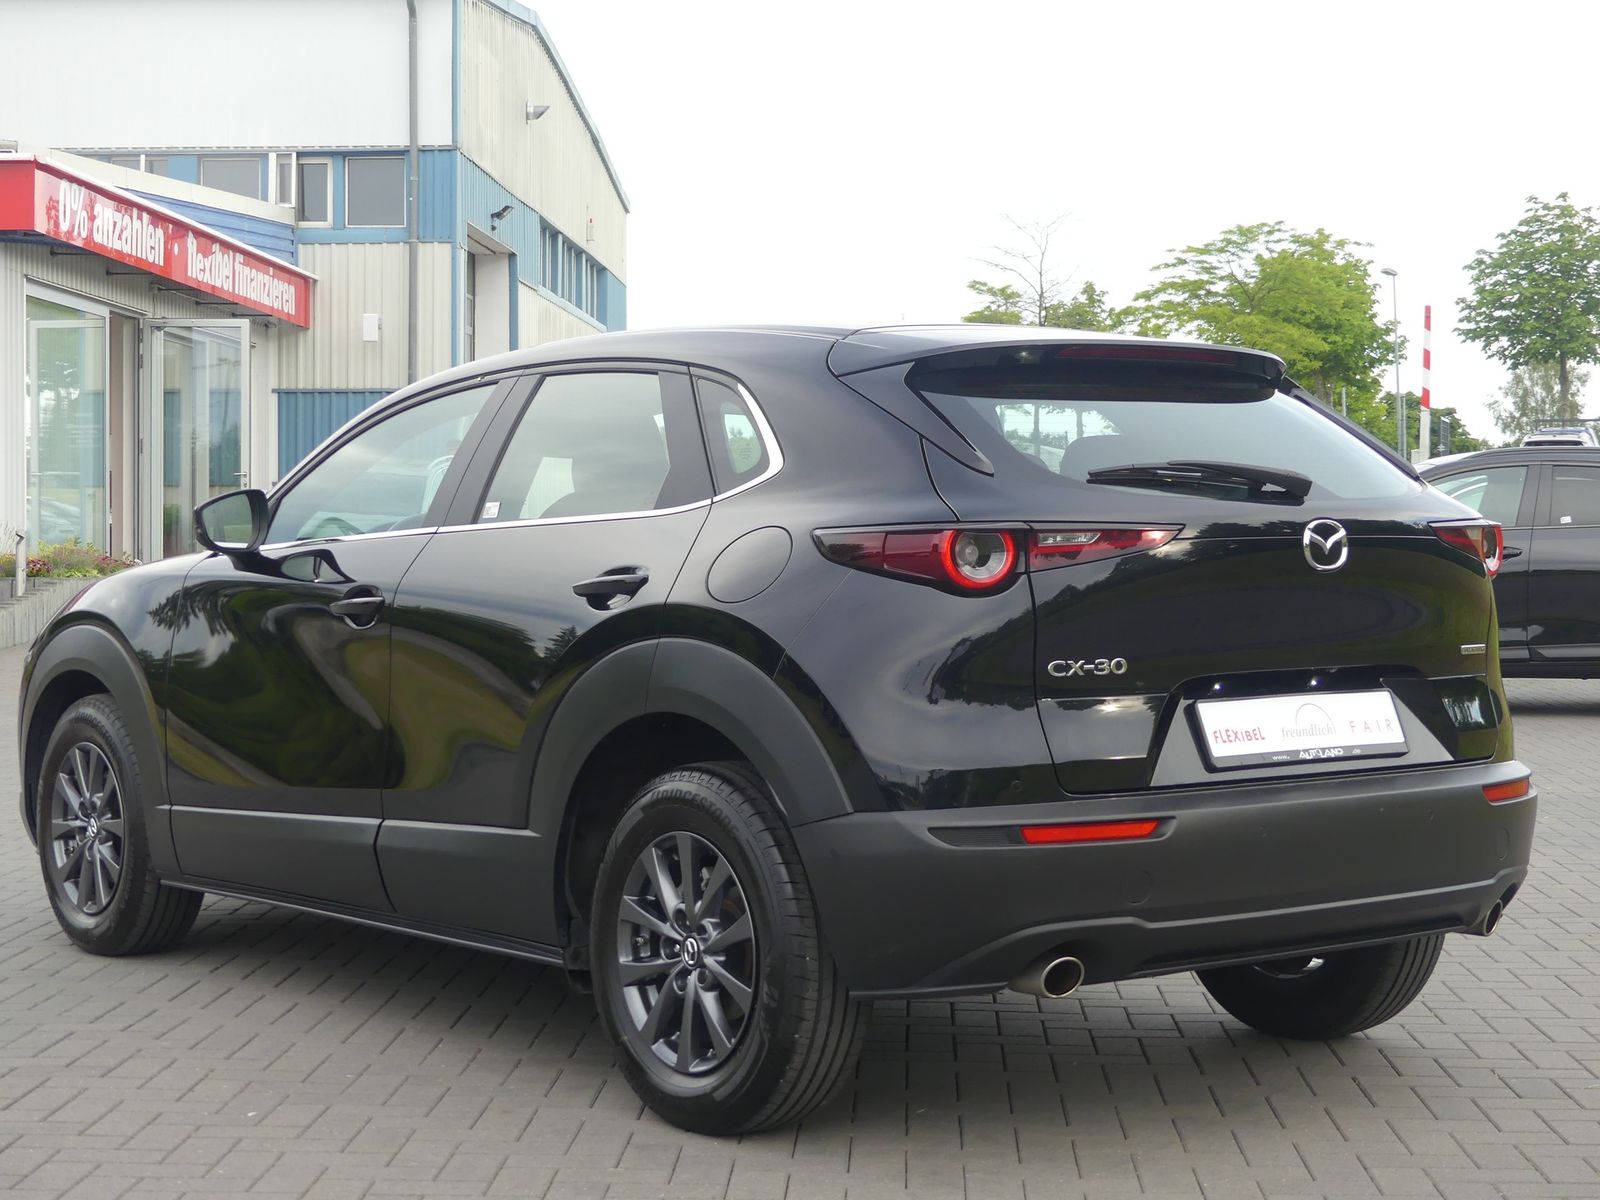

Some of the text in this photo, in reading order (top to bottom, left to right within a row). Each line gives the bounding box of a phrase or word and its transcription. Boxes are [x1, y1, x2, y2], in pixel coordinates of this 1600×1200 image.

[58, 178, 296, 316] 0% anzahlen flexibel finanzieren
[1047, 657, 1128, 677] CX-30
[1212, 726, 1266, 744] FLEXIBEL
[1281, 722, 1334, 739] freundlich
